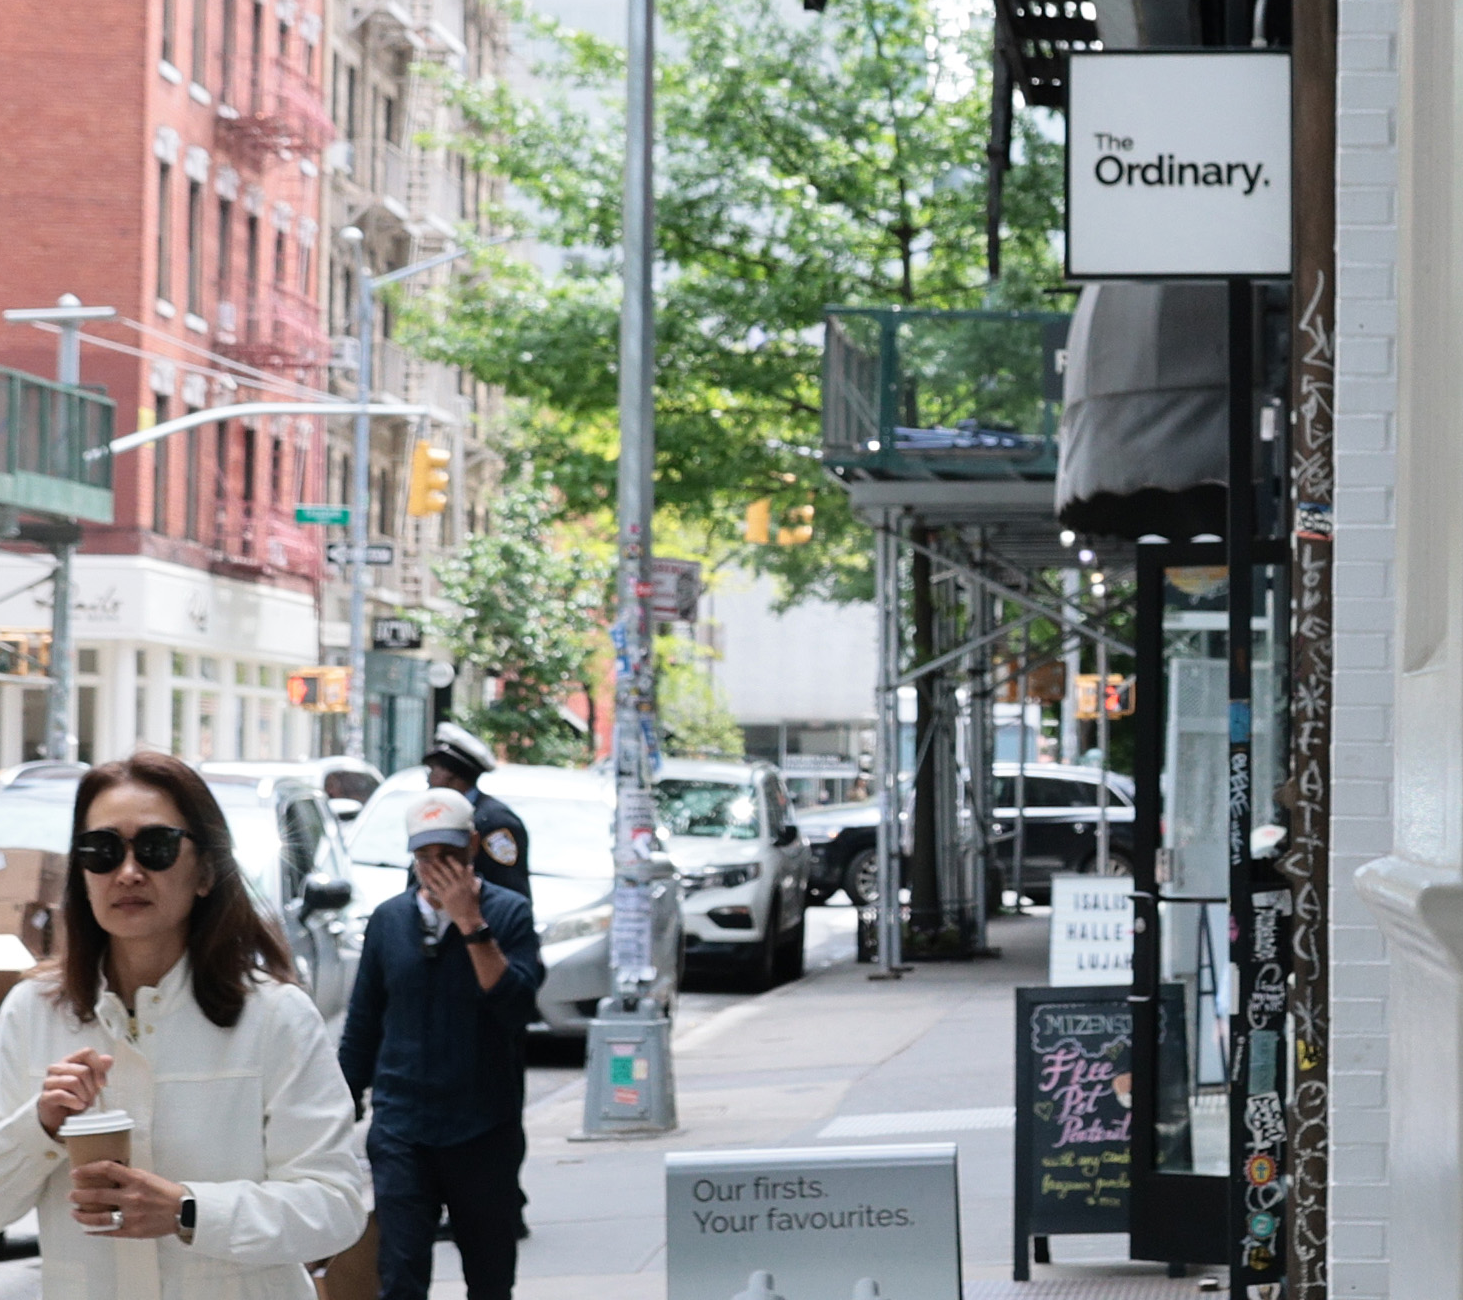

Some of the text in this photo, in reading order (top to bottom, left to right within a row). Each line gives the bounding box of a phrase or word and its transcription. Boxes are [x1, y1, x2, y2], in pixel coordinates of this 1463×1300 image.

[1095, 133, 1134, 151] The
[1095, 154, 1269, 196] Ordinary.
[1038, 1049, 1117, 1092] Free
[1052, 1083, 1114, 1124] Pet
[693, 1175, 829, 1202] Our firsts.
[693, 1204, 915, 1234] Your favourites.
